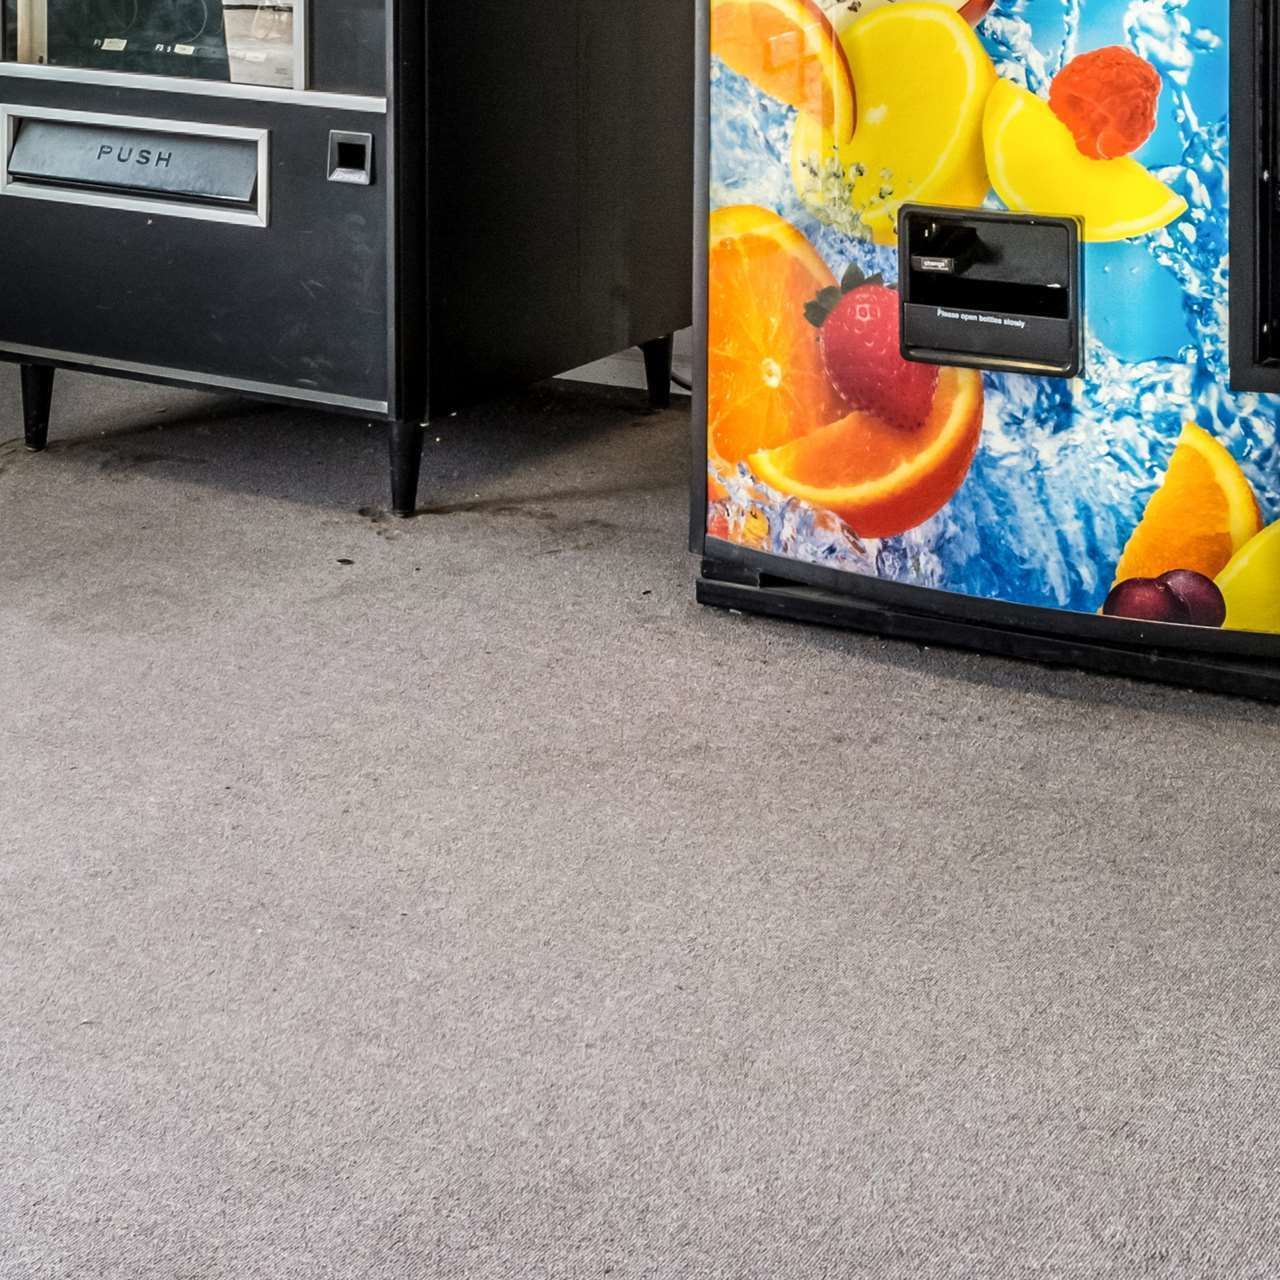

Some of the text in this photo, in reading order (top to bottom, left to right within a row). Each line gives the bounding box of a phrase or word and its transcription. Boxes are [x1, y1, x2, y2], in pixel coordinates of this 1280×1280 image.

[96, 144, 173, 168] PUSH
[937, 307, 1025, 329] Please open bottles slowly
